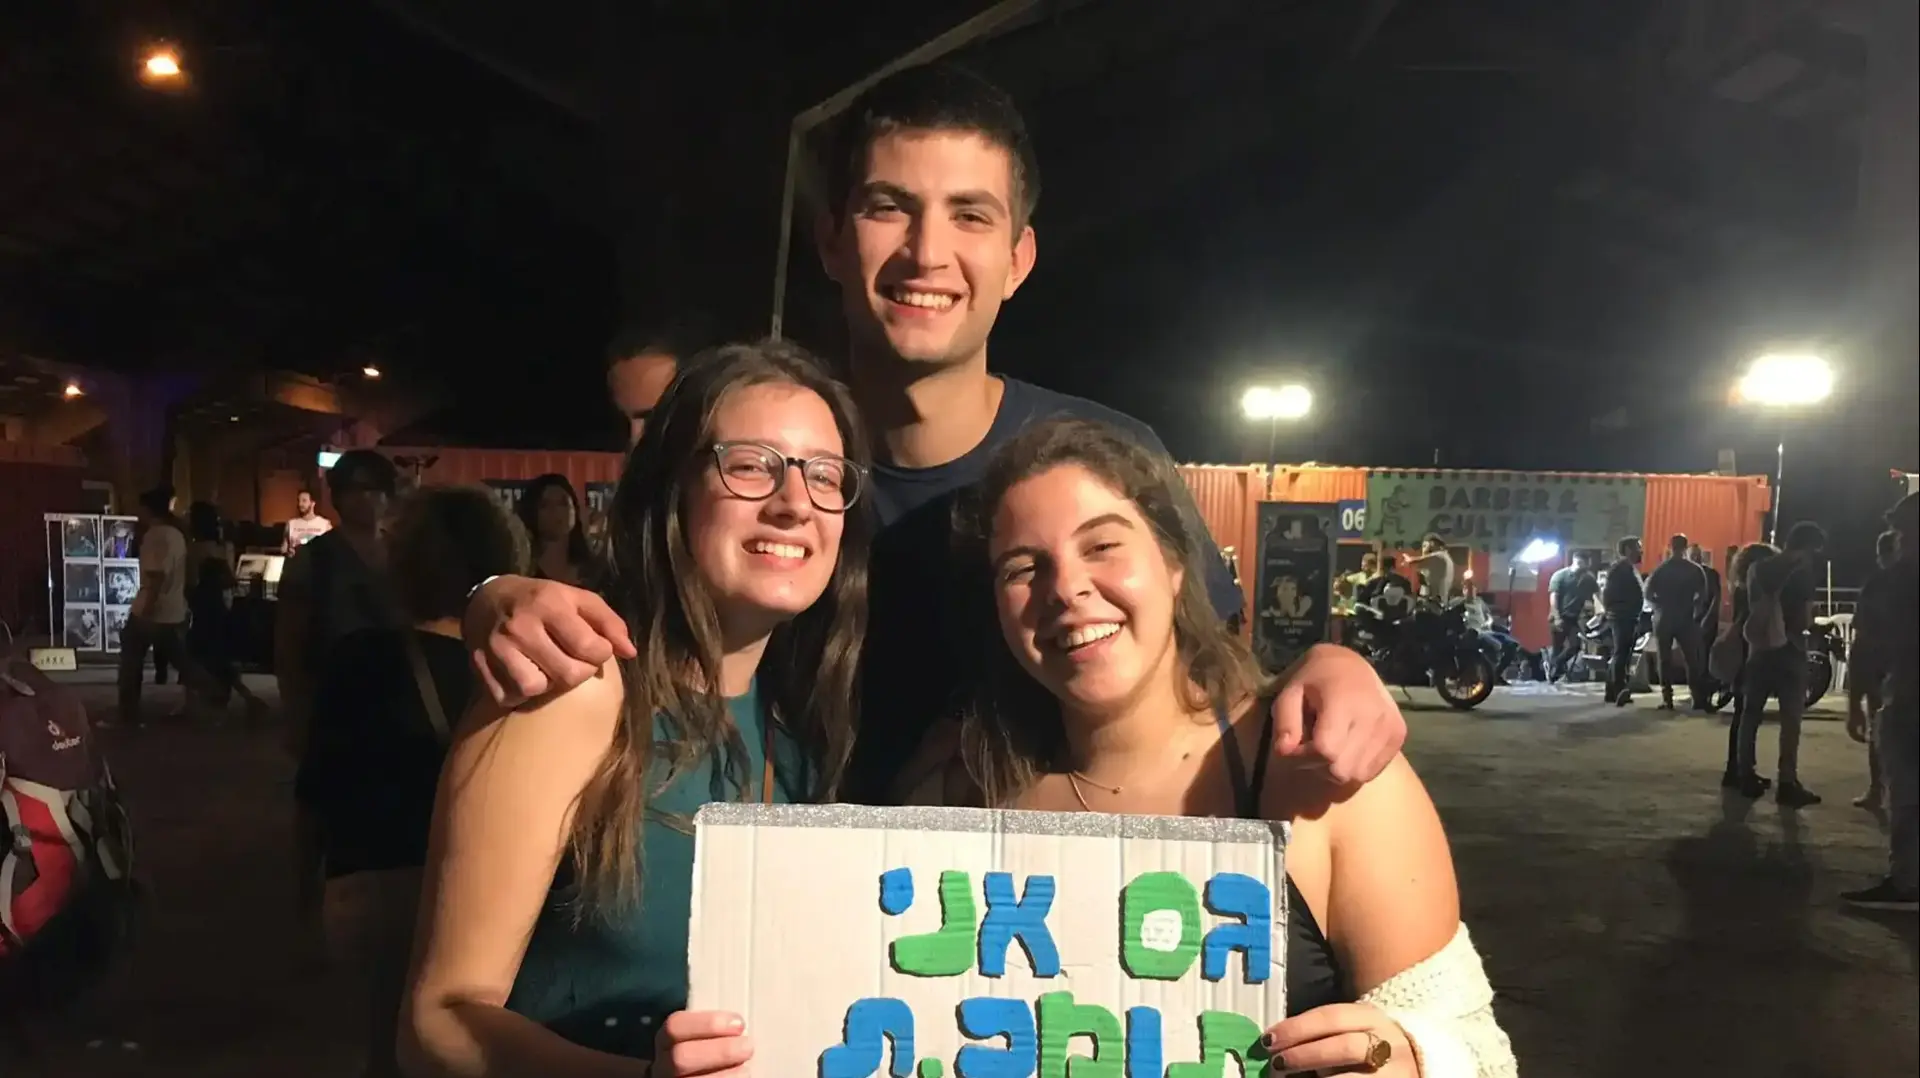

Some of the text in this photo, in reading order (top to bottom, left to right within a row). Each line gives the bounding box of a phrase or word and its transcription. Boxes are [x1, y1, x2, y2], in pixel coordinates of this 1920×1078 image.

[1428, 486, 1578, 512] BARBER &
[1342, 508, 1365, 531] 06
[879, 867, 1271, 984] גם אני
